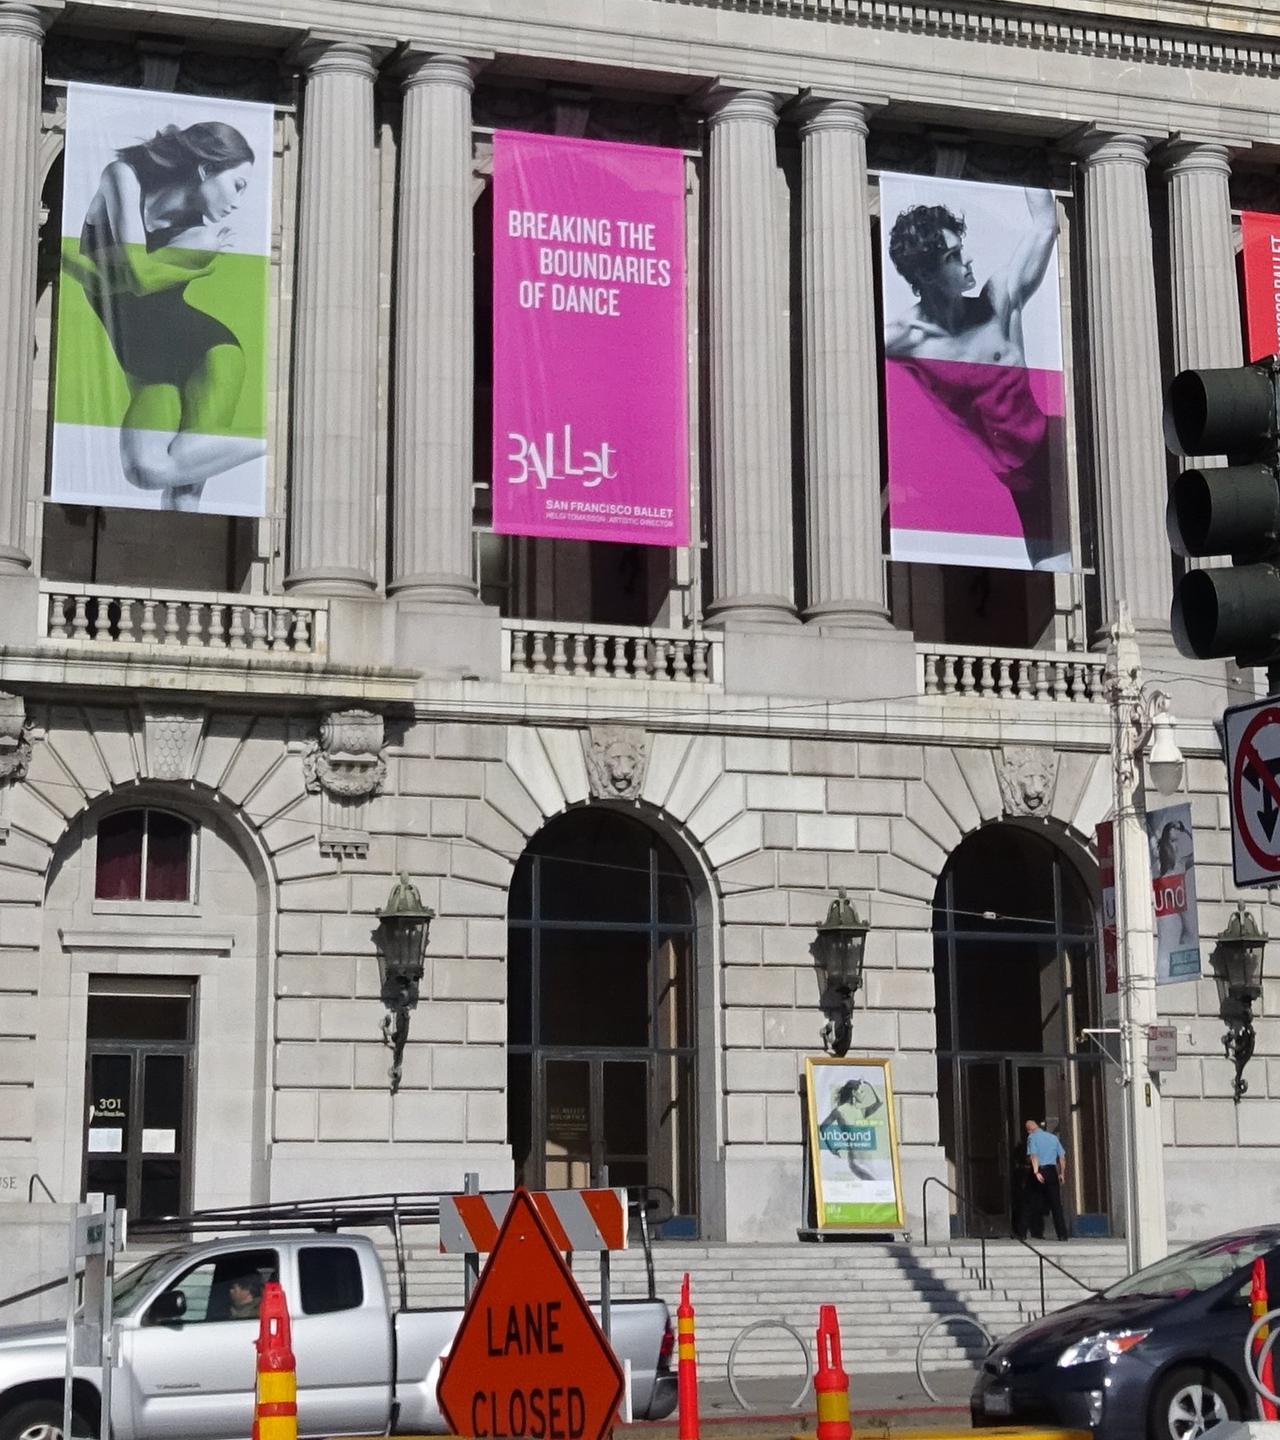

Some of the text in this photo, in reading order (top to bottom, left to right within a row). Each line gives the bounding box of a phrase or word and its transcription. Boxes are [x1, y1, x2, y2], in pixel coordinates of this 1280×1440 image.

[508, 210, 656, 251] BREAKING THE
[540, 247, 671, 287] BOUNDARIES
[520, 280, 621, 317] OF DANCE
[545, 499, 674, 519] SAN FRANCISCO BALLET
[640, 518, 674, 528] DIRECTOR
[99, 1098, 122, 1109] 301
[819, 1129, 872, 1142] unbound
[486, 1301, 564, 1357] LANE
[472, 1386, 586, 1439] CLOSED
